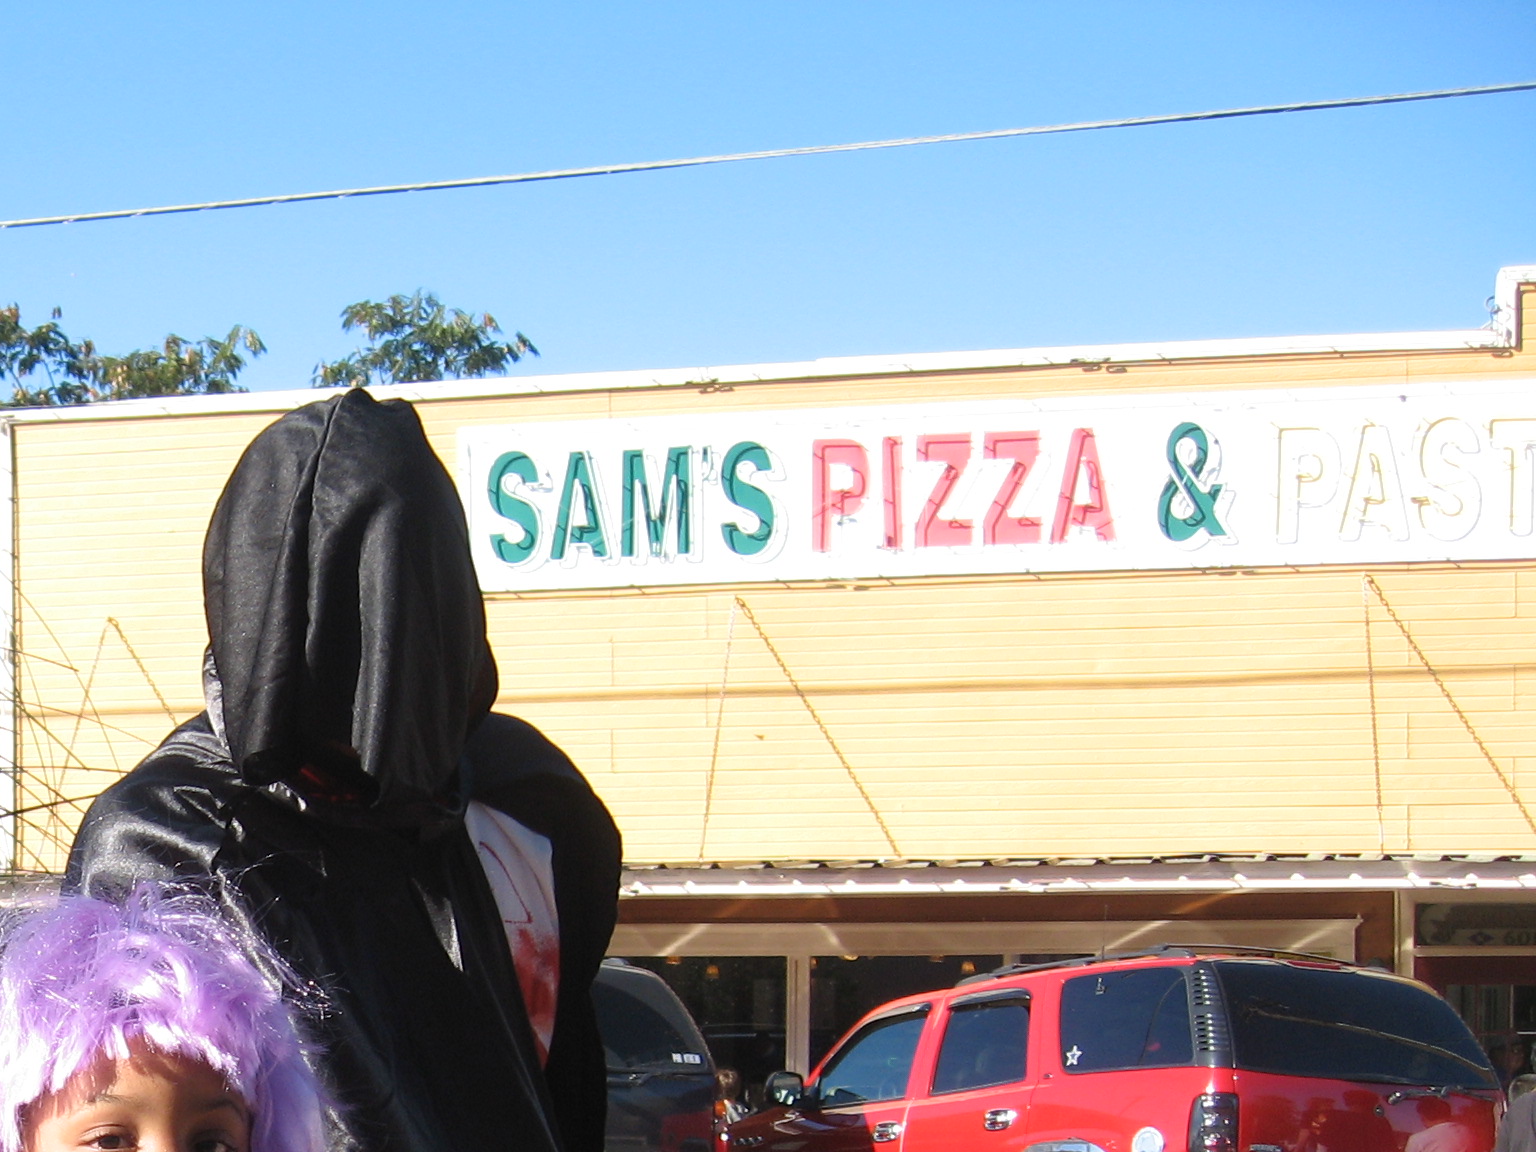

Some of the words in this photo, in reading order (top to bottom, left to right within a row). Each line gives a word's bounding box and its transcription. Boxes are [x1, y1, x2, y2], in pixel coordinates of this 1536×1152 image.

[486, 439, 786, 572] SAM'S
[811, 427, 1119, 553] PIZZA
[1157, 420, 1240, 552] &
